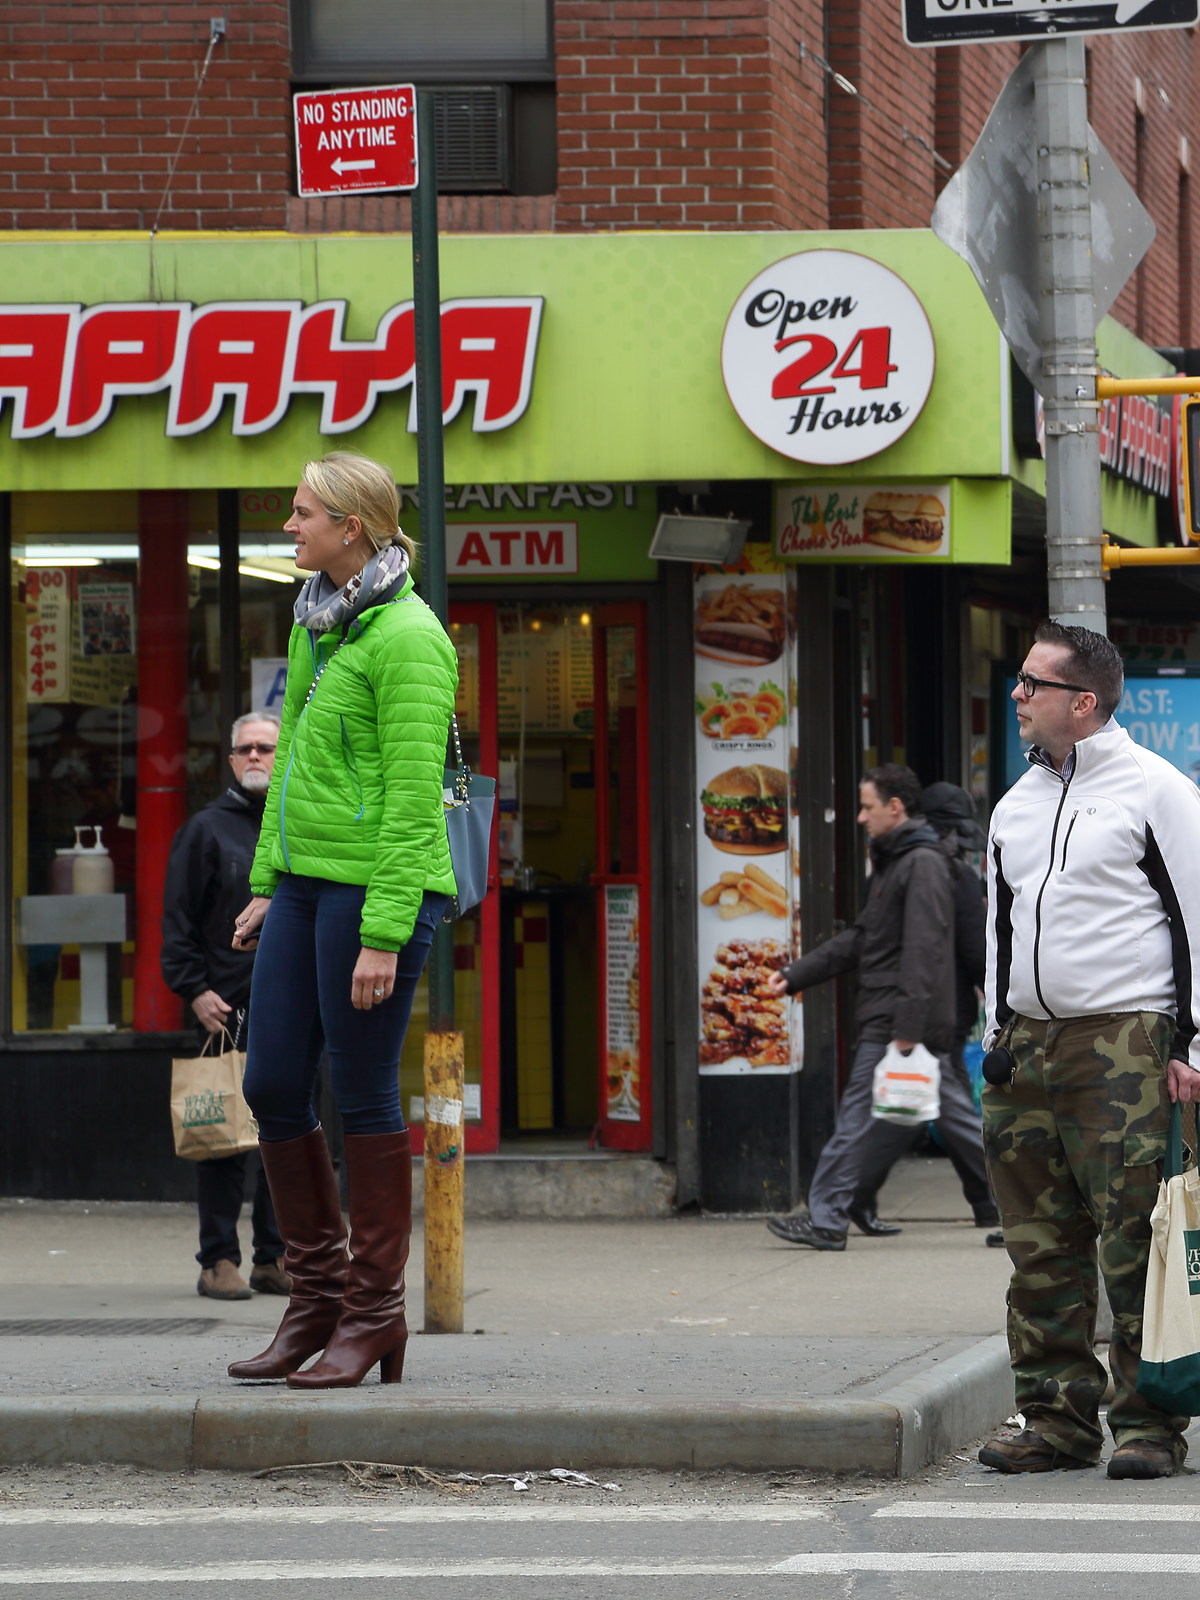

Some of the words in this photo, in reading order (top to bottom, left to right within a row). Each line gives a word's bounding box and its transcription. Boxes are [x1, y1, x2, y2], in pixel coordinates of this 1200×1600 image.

[303, 103, 325, 125] NO
[331, 96, 407, 122] STANDING
[317, 126, 397, 151] ANYTIME
[745, 288, 857, 339] Open
[771, 326, 898, 399] 24
[787, 395, 909, 436] Hours
[243, 493, 282, 513] GO
[792, 495, 818, 525] The
[824, 492, 859, 521] Best
[456, 531, 564, 567] ATM
[1136, 628, 1190, 645] BEST
[184, 1089, 227, 1107] WHOLE
[184, 1104, 225, 1121] FOODS
